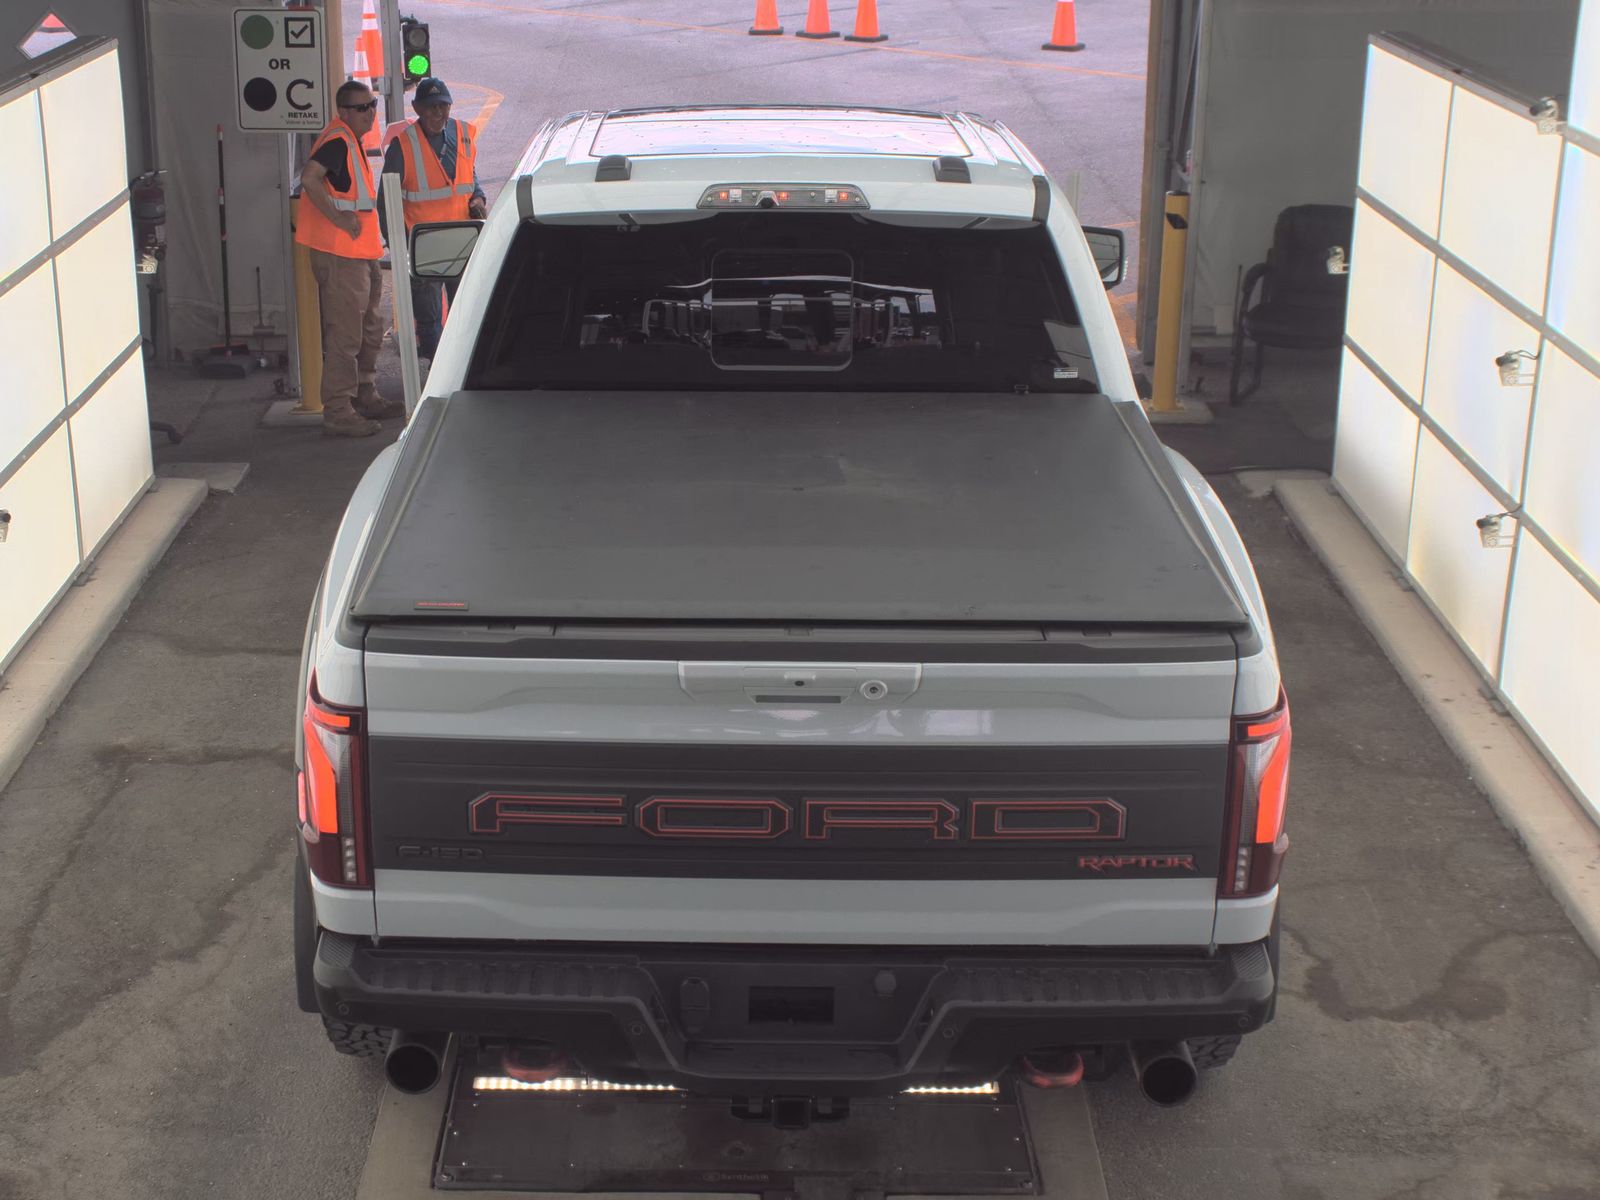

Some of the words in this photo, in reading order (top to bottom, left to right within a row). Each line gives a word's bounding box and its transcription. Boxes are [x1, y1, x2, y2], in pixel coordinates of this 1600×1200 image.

[268, 58, 290, 70] OR
[469, 792, 1126, 839] FORD
[1077, 855, 1197, 873] RAPTOR
